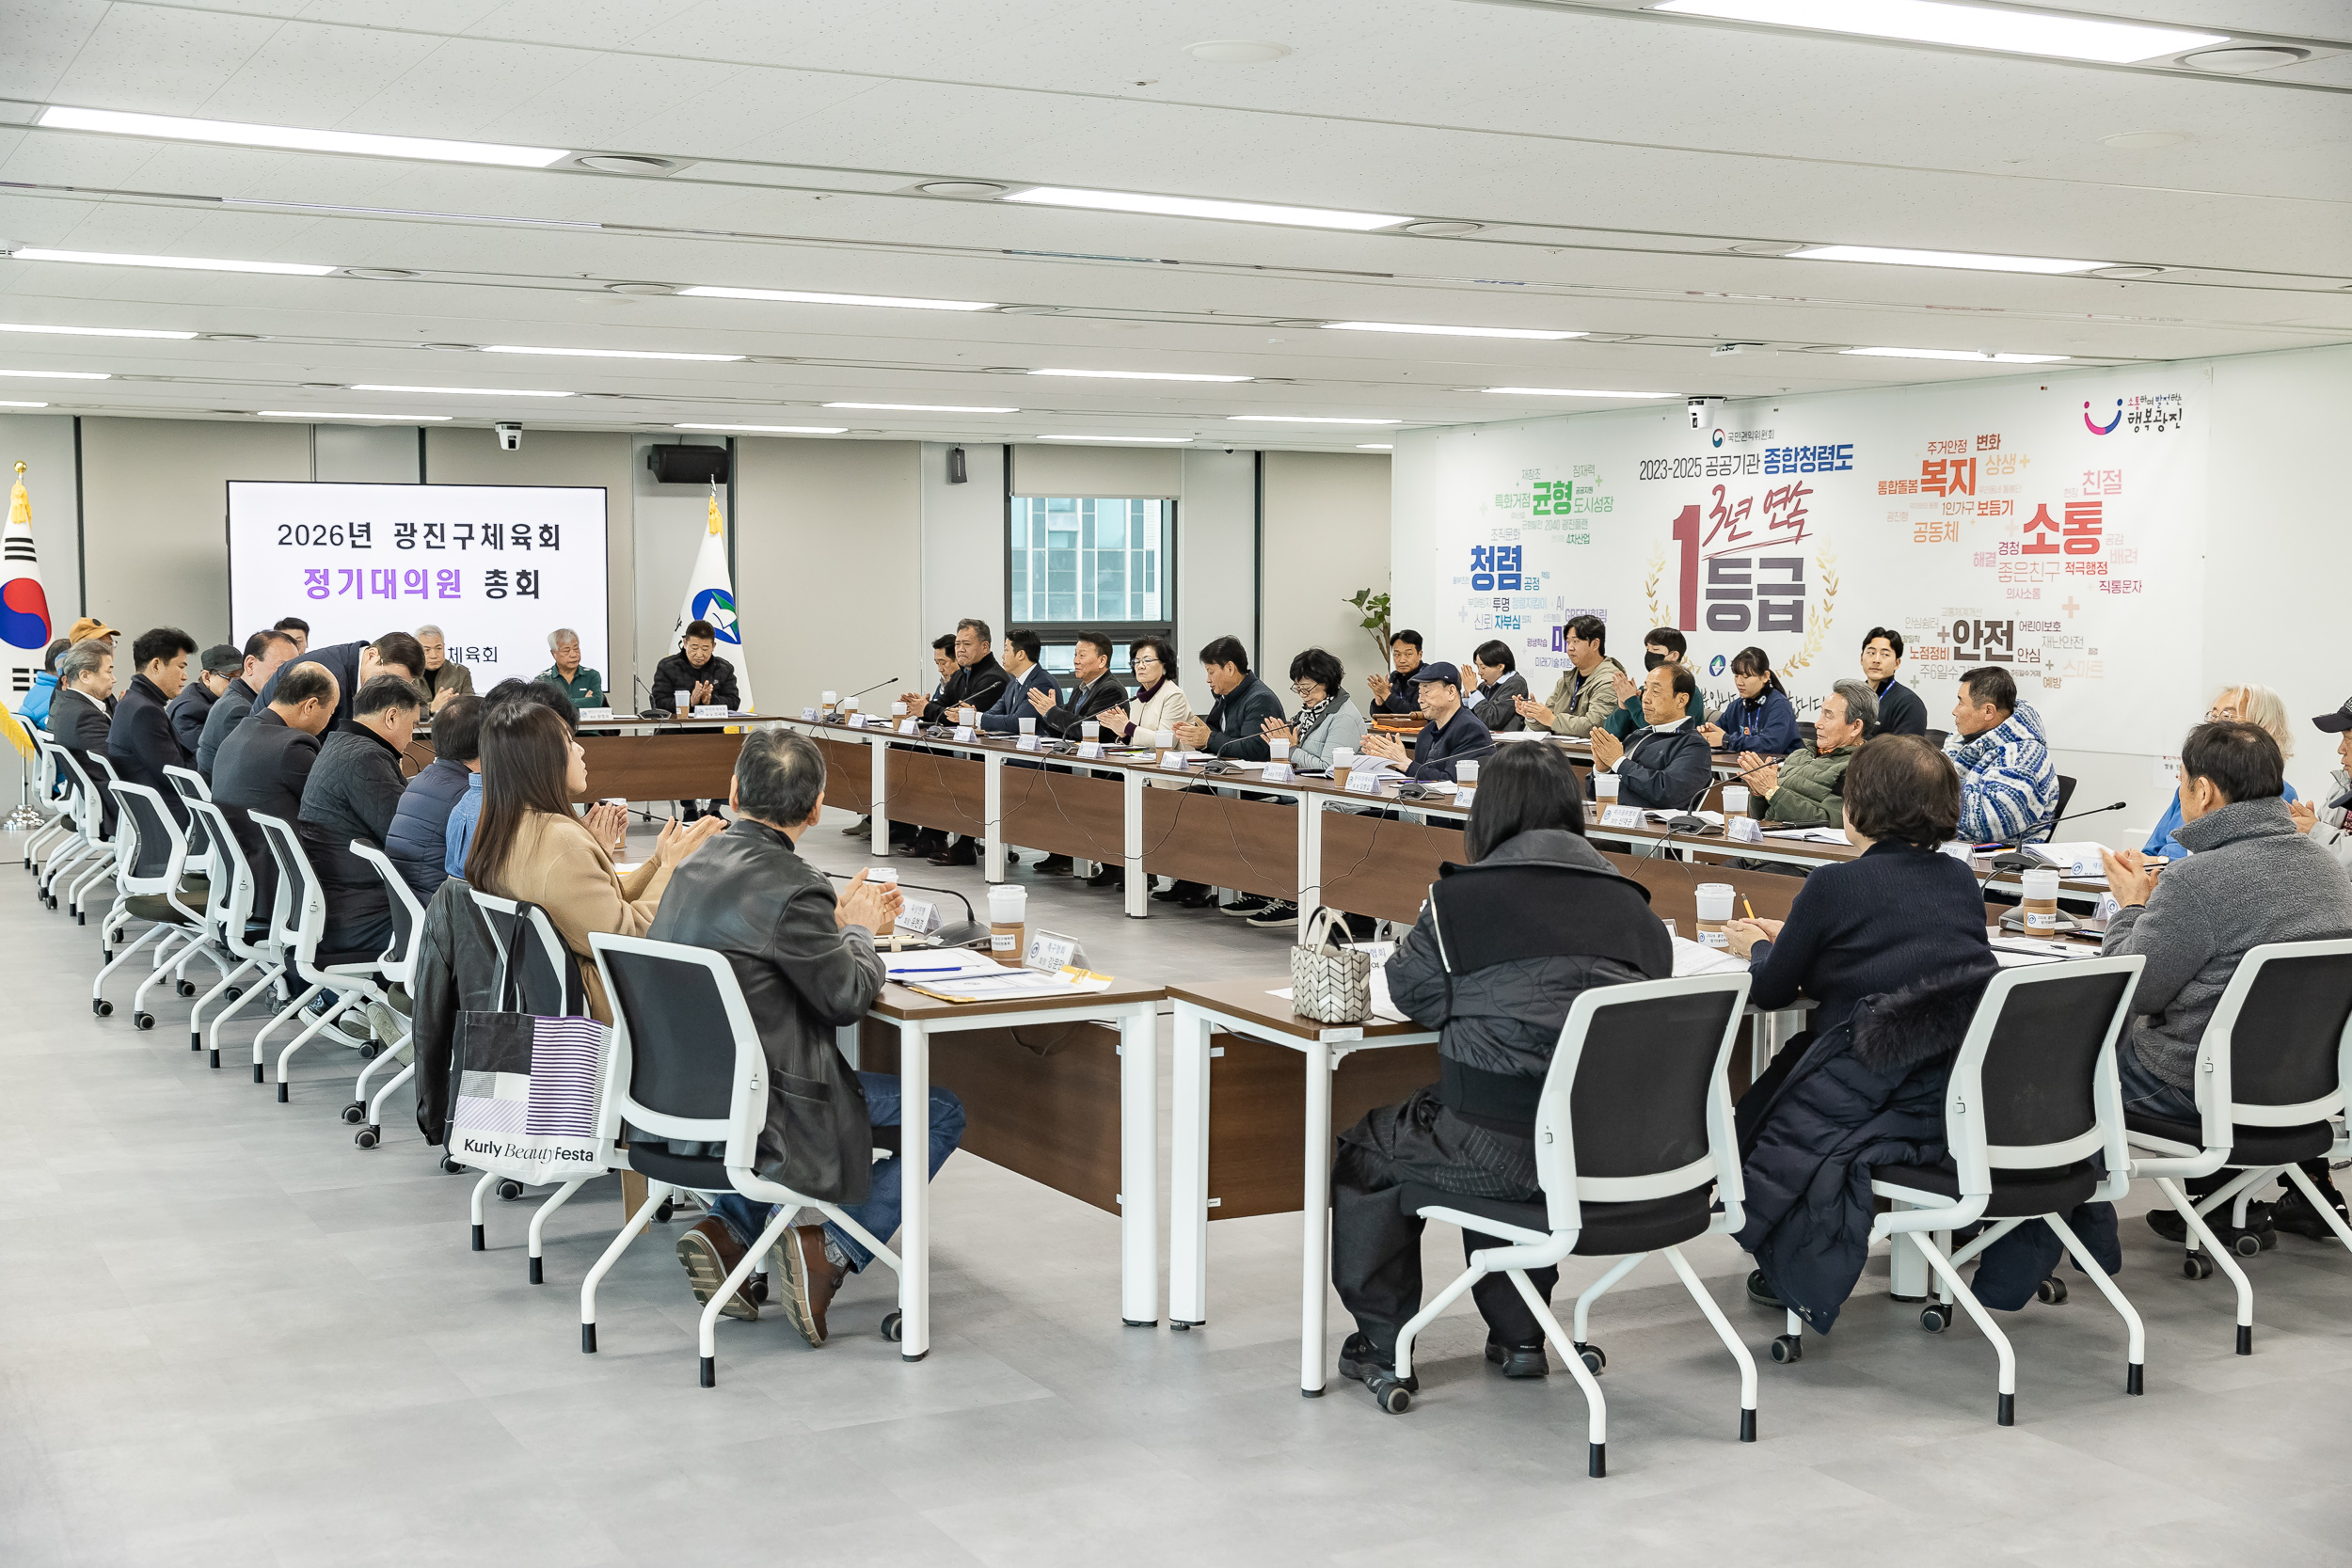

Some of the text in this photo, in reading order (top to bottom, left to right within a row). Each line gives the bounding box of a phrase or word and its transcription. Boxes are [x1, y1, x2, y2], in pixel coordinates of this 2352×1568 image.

[2127, 407, 2183, 433] 행복광진
[1727, 429, 1774, 443] 국민권익위원회
[1977, 434, 2001, 451] 변화
[1928, 439, 1967, 455] 주거안정
[1572, 464, 1595, 478] 잠재력
[1639, 444, 1853, 481] 2023-2025 공공기관 종합청렴도
[1985, 453, 2016, 476] 상생
[1521, 468, 1541, 481] 재창조
[1920, 457, 1977, 498] 복지
[2082, 469, 2122, 496] 친절
[1878, 479, 1918, 496] 통합돌봄
[1494, 493, 1531, 509] 특화거점
[1533, 481, 1573, 515] 균형
[1574, 496, 1613, 514] 도시성장
[1702, 480, 1814, 547] 3년 연속
[1942, 501, 1975, 516] 1인가구
[1977, 499, 2013, 516] 보듬기
[1544, 519, 1561, 531] 2040
[1914, 521, 1960, 543] 공동체
[2022, 500, 2103, 555] 소통
[278, 521, 562, 552] 2026년 광진구체육회
[1490, 528, 1520, 542] 조직문화
[1565, 533, 1591, 545] 4차산업
[2106, 533, 2123, 546] 공감
[1998, 542, 2020, 556] 경청
[2109, 548, 2137, 565] 배려
[1470, 545, 1522, 591] 청렴
[1973, 551, 1996, 568] 해결
[1997, 561, 2060, 583] 좋은친구
[2065, 562, 2108, 576] 적극행정
[303, 567, 541, 601] 정기대의원 총회
[1524, 577, 1540, 591] 공정
[2099, 580, 2142, 594] 직통문자
[2006, 587, 2041, 600] 의사소통
[1492, 597, 1510, 612] 투명
[1512, 596, 1547, 610] 청렴지킴이
[1556, 595, 1565, 610] AI
[1473, 613, 1493, 630] 신뢰
[1494, 614, 1521, 630] 자부심
[1904, 617, 1939, 630] 안심쉼터
[2019, 621, 2061, 632] 어린이보호
[1952, 619, 2014, 662] 안전
[2042, 635, 2084, 650] 재난안전
[1909, 646, 1950, 660] 노점정비
[2017, 647, 2041, 664] 안심
[2061, 659, 2104, 679] 스마트
[2042, 676, 2062, 689] 예방
[464, 1138, 594, 1164] Kurly Beauty Festa
